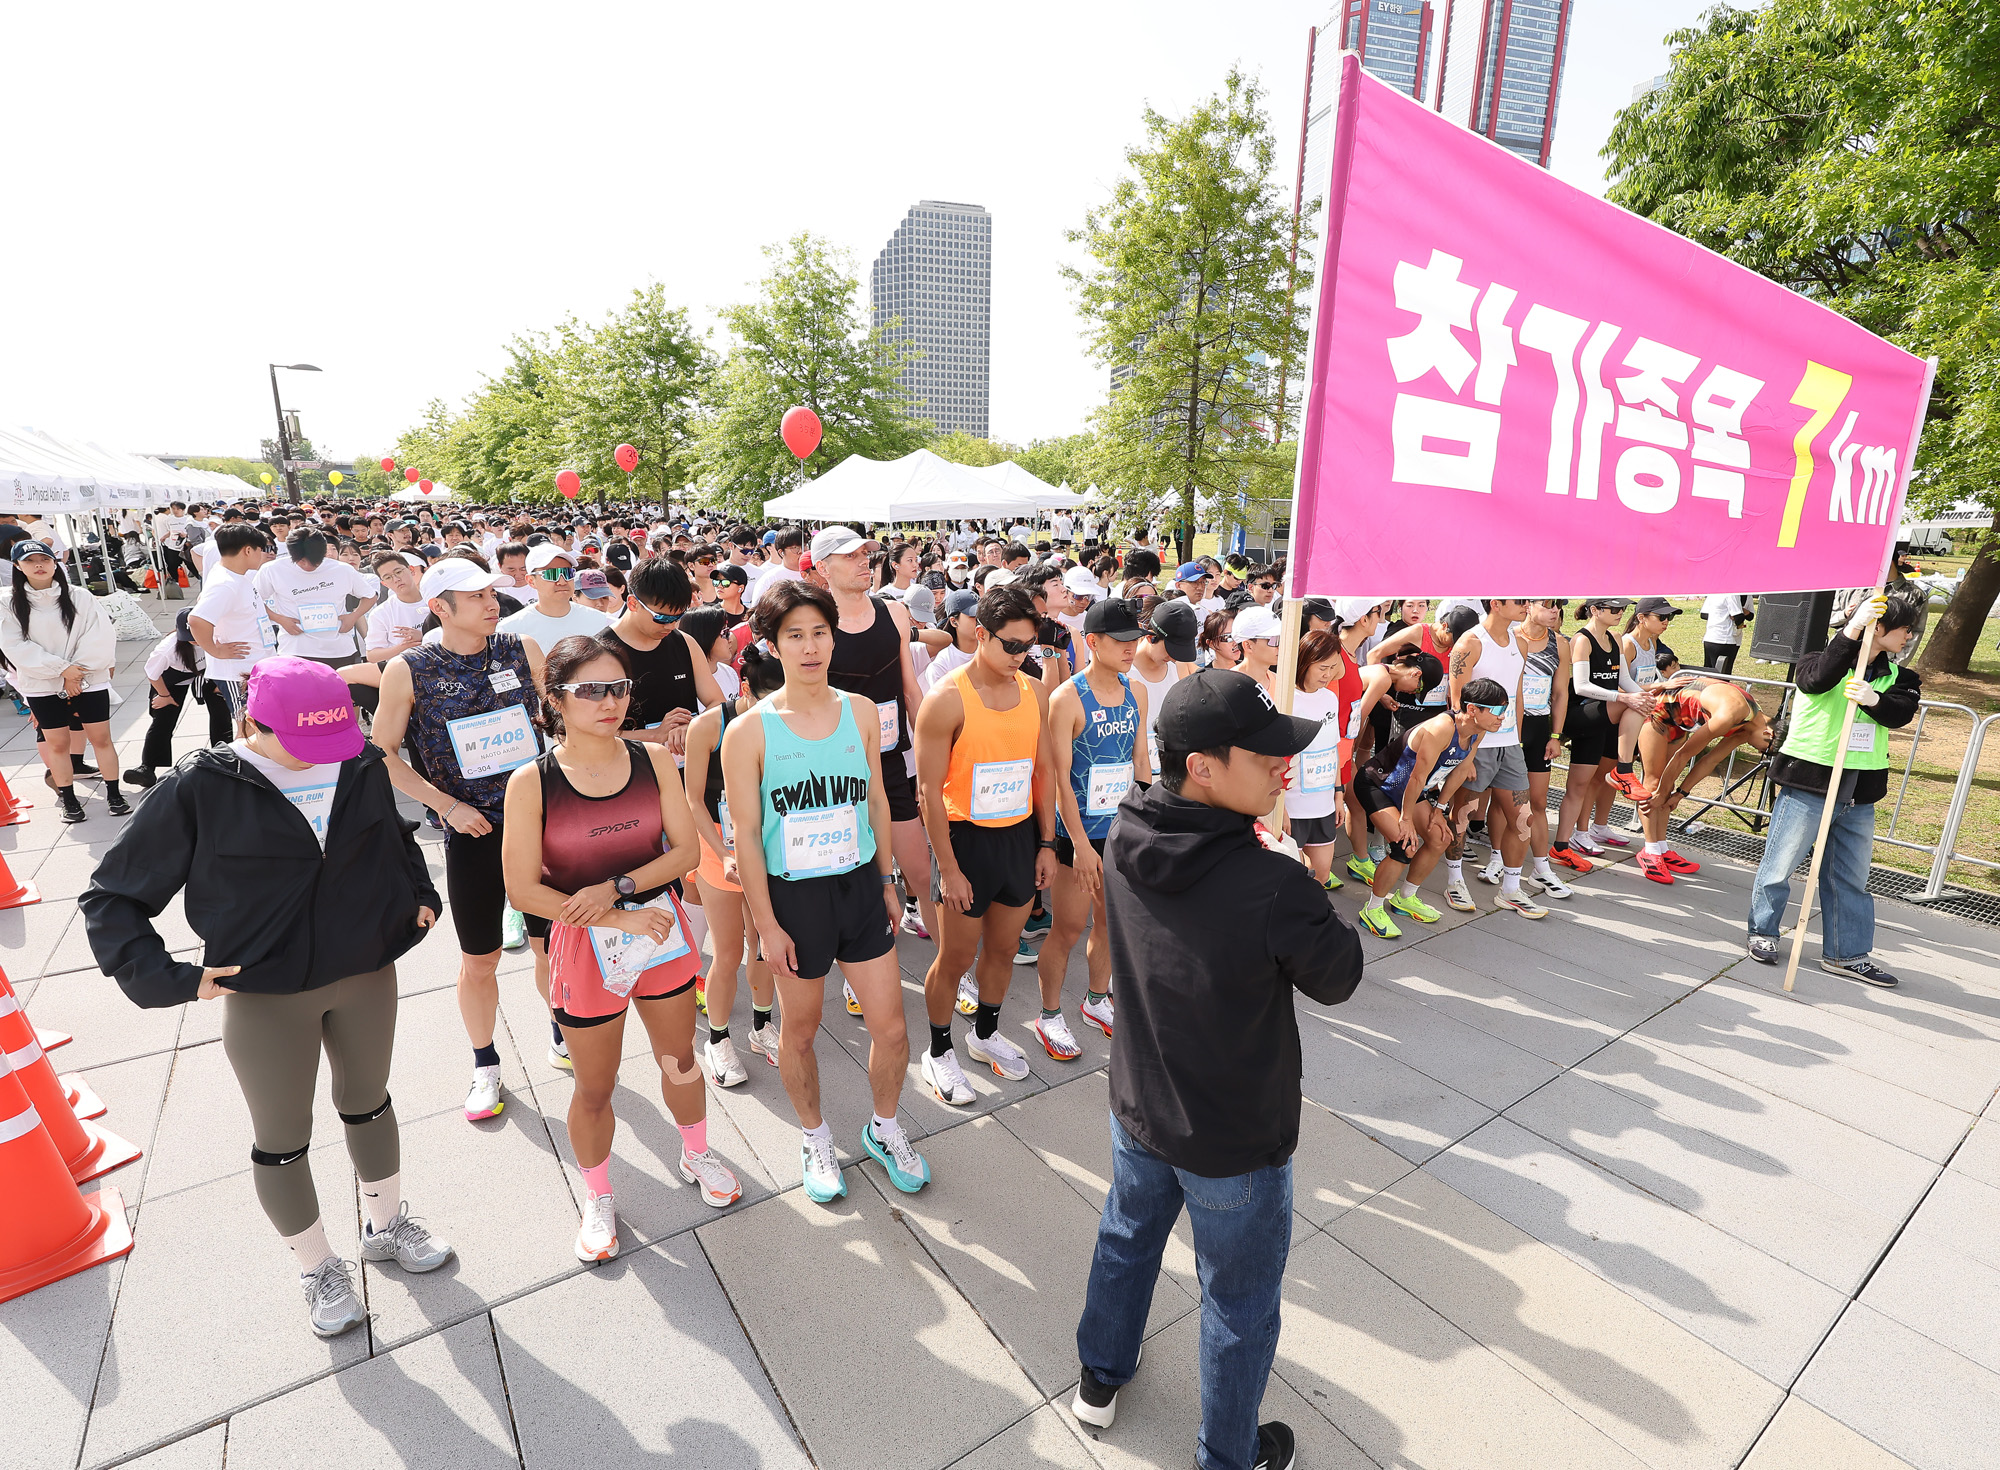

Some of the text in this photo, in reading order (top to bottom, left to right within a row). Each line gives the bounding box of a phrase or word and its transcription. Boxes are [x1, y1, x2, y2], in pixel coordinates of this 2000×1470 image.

[1386, 248, 1765, 519] 참가종목
[1933, 510, 1995, 520] RNING RU
[292, 581, 334, 596] Burning Run
[311, 612, 334, 620] 7007
[297, 706, 348, 727] HOKA
[456, 719, 487, 731] BURNING
[487, 716, 502, 725] RUN
[1097, 719, 1135, 738] KOREA
[465, 727, 525, 752] M 7408
[480, 745, 520, 760] NAOTO AKIBA
[467, 764, 491, 775] C-304
[981, 780, 1025, 795] M 7347
[1095, 784, 1103, 792] M
[305, 791, 325, 801] RUN
[789, 812, 835, 823] BURNING RUN
[587, 819, 640, 838] SPYDER
[792, 827, 852, 848] M 7395
[838, 852, 856, 864] B-27
[604, 935, 618, 949] W
